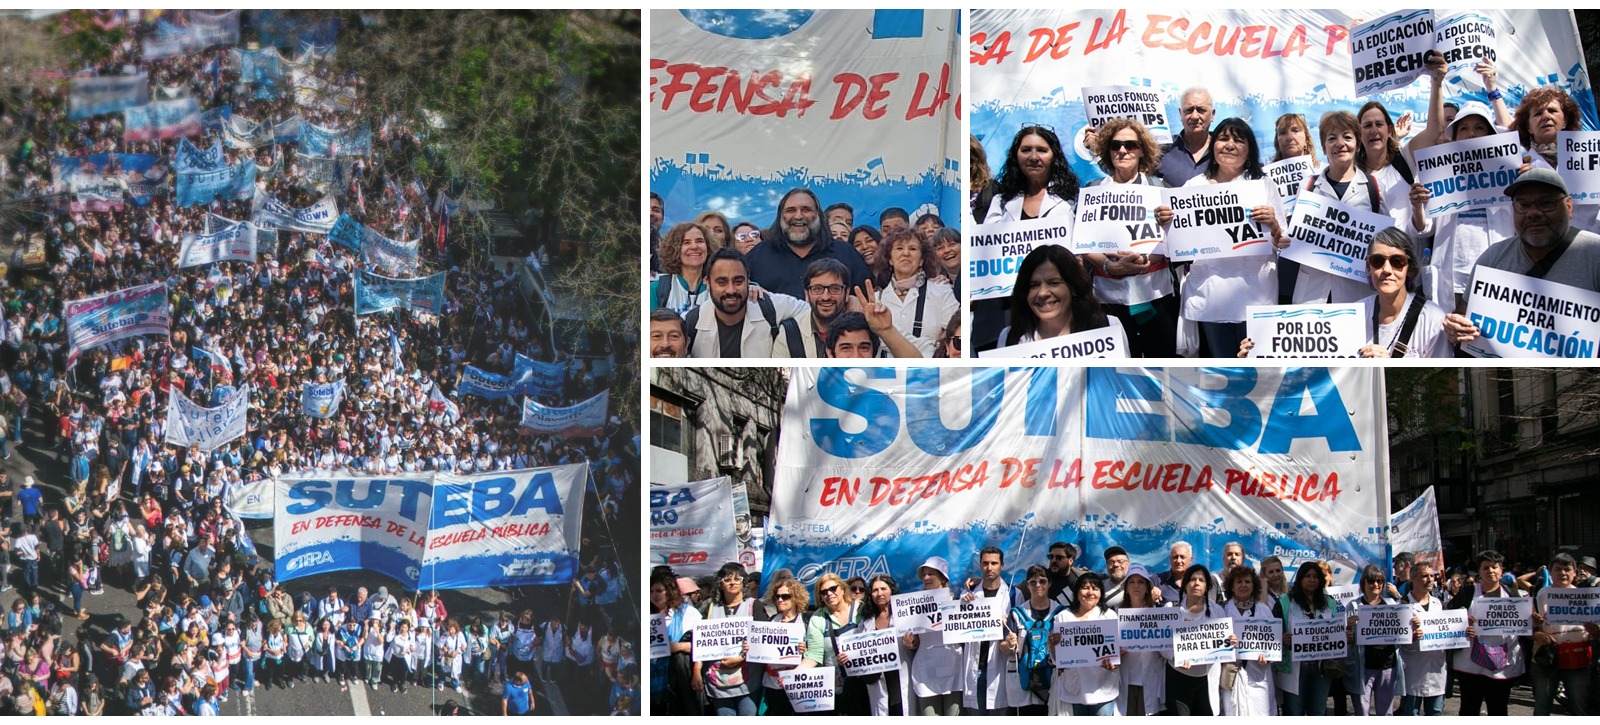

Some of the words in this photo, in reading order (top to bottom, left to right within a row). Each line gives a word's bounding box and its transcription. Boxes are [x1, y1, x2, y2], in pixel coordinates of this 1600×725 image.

[1023, 21, 1081, 63] DE
[1084, 9, 1130, 56] LA
[1141, 14, 1313, 60] ESCUELA
[1352, 39, 1365, 55] LA
[1366, 18, 1434, 49] EDUCACIÓN
[1445, 22, 1496, 40] EDUCACIÓN
[1454, 36, 1466, 47] ES
[1468, 34, 1481, 44] UN
[1376, 47, 1388, 59] ES
[1390, 43, 1405, 56] UN
[1443, 44, 1497, 64] ERECHO
[1354, 49, 1439, 84] DERECHO
[829, 72, 900, 120] DE
[905, 62, 951, 121] LA
[1088, 95, 1106, 104] POR
[1108, 93, 1123, 103] LOS
[1124, 92, 1159, 103] FONDOS
[1096, 103, 1157, 115] NACIONALES
[1142, 113, 1165, 126] IPS
[1418, 143, 1518, 172] FINANCIAMIENTO
[1566, 156, 1584, 171] del
[1270, 161, 1308, 178] FONDOS
[1452, 161, 1484, 176] PARA
[1424, 165, 1521, 199] EDUCACIÓN
[1083, 190, 1143, 206] Restitución
[1170, 190, 1239, 210] Restitución
[1082, 209, 1097, 222] del
[1100, 205, 1147, 221] FONID
[1173, 216, 1192, 229] del
[1195, 205, 1245, 227] FONID
[1326, 206, 1350, 224] NO
[1350, 220, 1357, 228] A
[1360, 222, 1375, 233] LAS
[1126, 223, 1162, 241] YA!
[1225, 221, 1264, 243] YA!
[1302, 213, 1374, 245] REFORMAS
[1002, 243, 1033, 257] PARA
[1288, 225, 1368, 261] JUBILATORI
[1473, 280, 1600, 323] FINANCIAMIENTO
[1517, 308, 1555, 330] PARA
[1277, 321, 1303, 335] POR
[1307, 321, 1332, 335] LOS
[1470, 312, 1594, 358] EDUCACIÓN
[1051, 336, 1116, 358] FONDOS
[1272, 336, 1338, 353] FONDOS
[809, 367, 1363, 460] SUTEBA
[820, 476, 861, 508] EN
[868, 460, 989, 508] DEFENSA
[1000, 457, 1038, 489] DE
[1049, 458, 1085, 489] LA
[1092, 460, 1215, 494] ESCUELA
[1224, 464, 1342, 502] PÚBLICA
[286, 472, 565, 530] SUTEBA
[291, 519, 311, 535] EN
[315, 514, 382, 530] DEFENSA
[386, 520, 408, 538] DE
[408, 531, 426, 547] LA
[429, 528, 487, 550] ESCUELA
[491, 522, 551, 538] PÚBLICA
[791, 523, 831, 533] SUTEBA
[1273, 545, 1316, 559] Buenos
[1318, 549, 1349, 560] Aires
[896, 594, 935, 607] Restitución
[897, 609, 908, 617] del
[909, 602, 938, 615] FONID
[960, 604, 974, 612] NO
[1486, 611, 1519, 619] FONDOS
[948, 611, 991, 621] REFORMAS
[1120, 613, 1179, 622] FINANCIAMIENTO
[1369, 619, 1401, 627] FONDOS
[1423, 618, 1448, 626] FONDOS
[1478, 619, 1528, 627] EDUCATIVOS
[720, 620, 748, 629] FONDOS
[751, 625, 788, 635] Restitución
[944, 619, 1002, 632] JUBILATORIAS
[1060, 625, 1102, 636] Restitución
[1200, 622, 1229, 632] FONDOS
[1293, 628, 1304, 636] LA
[1305, 622, 1345, 635] EDUCACIÓN
[1361, 627, 1409, 636] EDUCATIVOS
[701, 628, 745, 638] NACIONALES
[1121, 625, 1173, 640] EDUCACIÓ
[1180, 631, 1225, 641] NACIONALES
[1241, 633, 1275, 642] FONDOS
[1421, 630, 1467, 641] NIVERSIDADE
[696, 638, 718, 648] PARA
[720, 637, 730, 645] EL
[751, 636, 760, 644] del
[761, 635, 790, 645] FONID
[852, 636, 895, 651] EDUCACIÓN
[1060, 638, 1072, 647] del
[1074, 634, 1104, 646] FONID
[1177, 641, 1198, 652] PARA
[1200, 641, 1211, 650] EL
[1212, 638, 1231, 649] IPS
[1238, 641, 1281, 651] DUCATIVOS
[1294, 640, 1345, 653] DERECHO
[777, 646, 799, 656] YA!
[868, 647, 878, 655] UN
[1092, 644, 1116, 657] YA!
[845, 652, 897, 669] DERECHO
[794, 673, 808, 682] NO
[785, 681, 824, 691] REFORMAS
[788, 689, 834, 701] BILATORIAS
